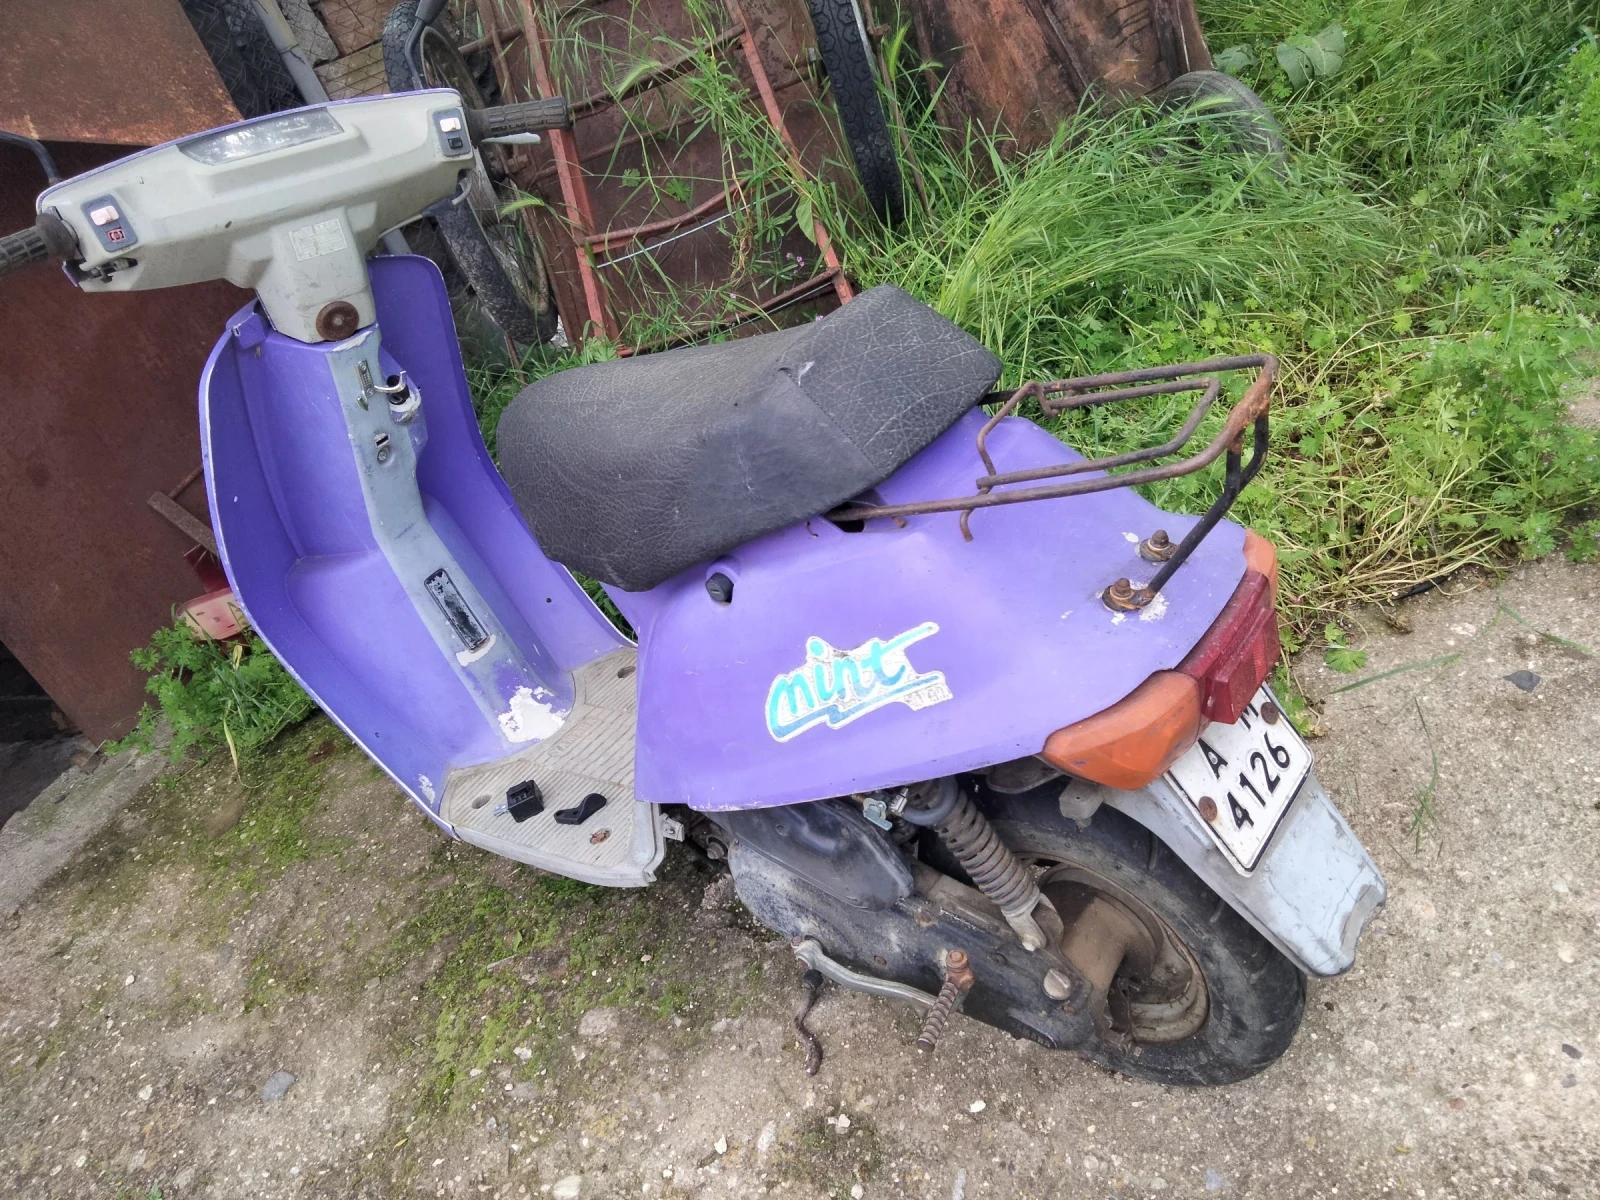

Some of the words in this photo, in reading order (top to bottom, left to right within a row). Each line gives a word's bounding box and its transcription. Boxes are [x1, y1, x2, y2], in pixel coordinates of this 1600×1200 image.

[768, 626, 937, 738] mint
[1197, 738, 1229, 780] A
[1226, 732, 1291, 830] 4126
